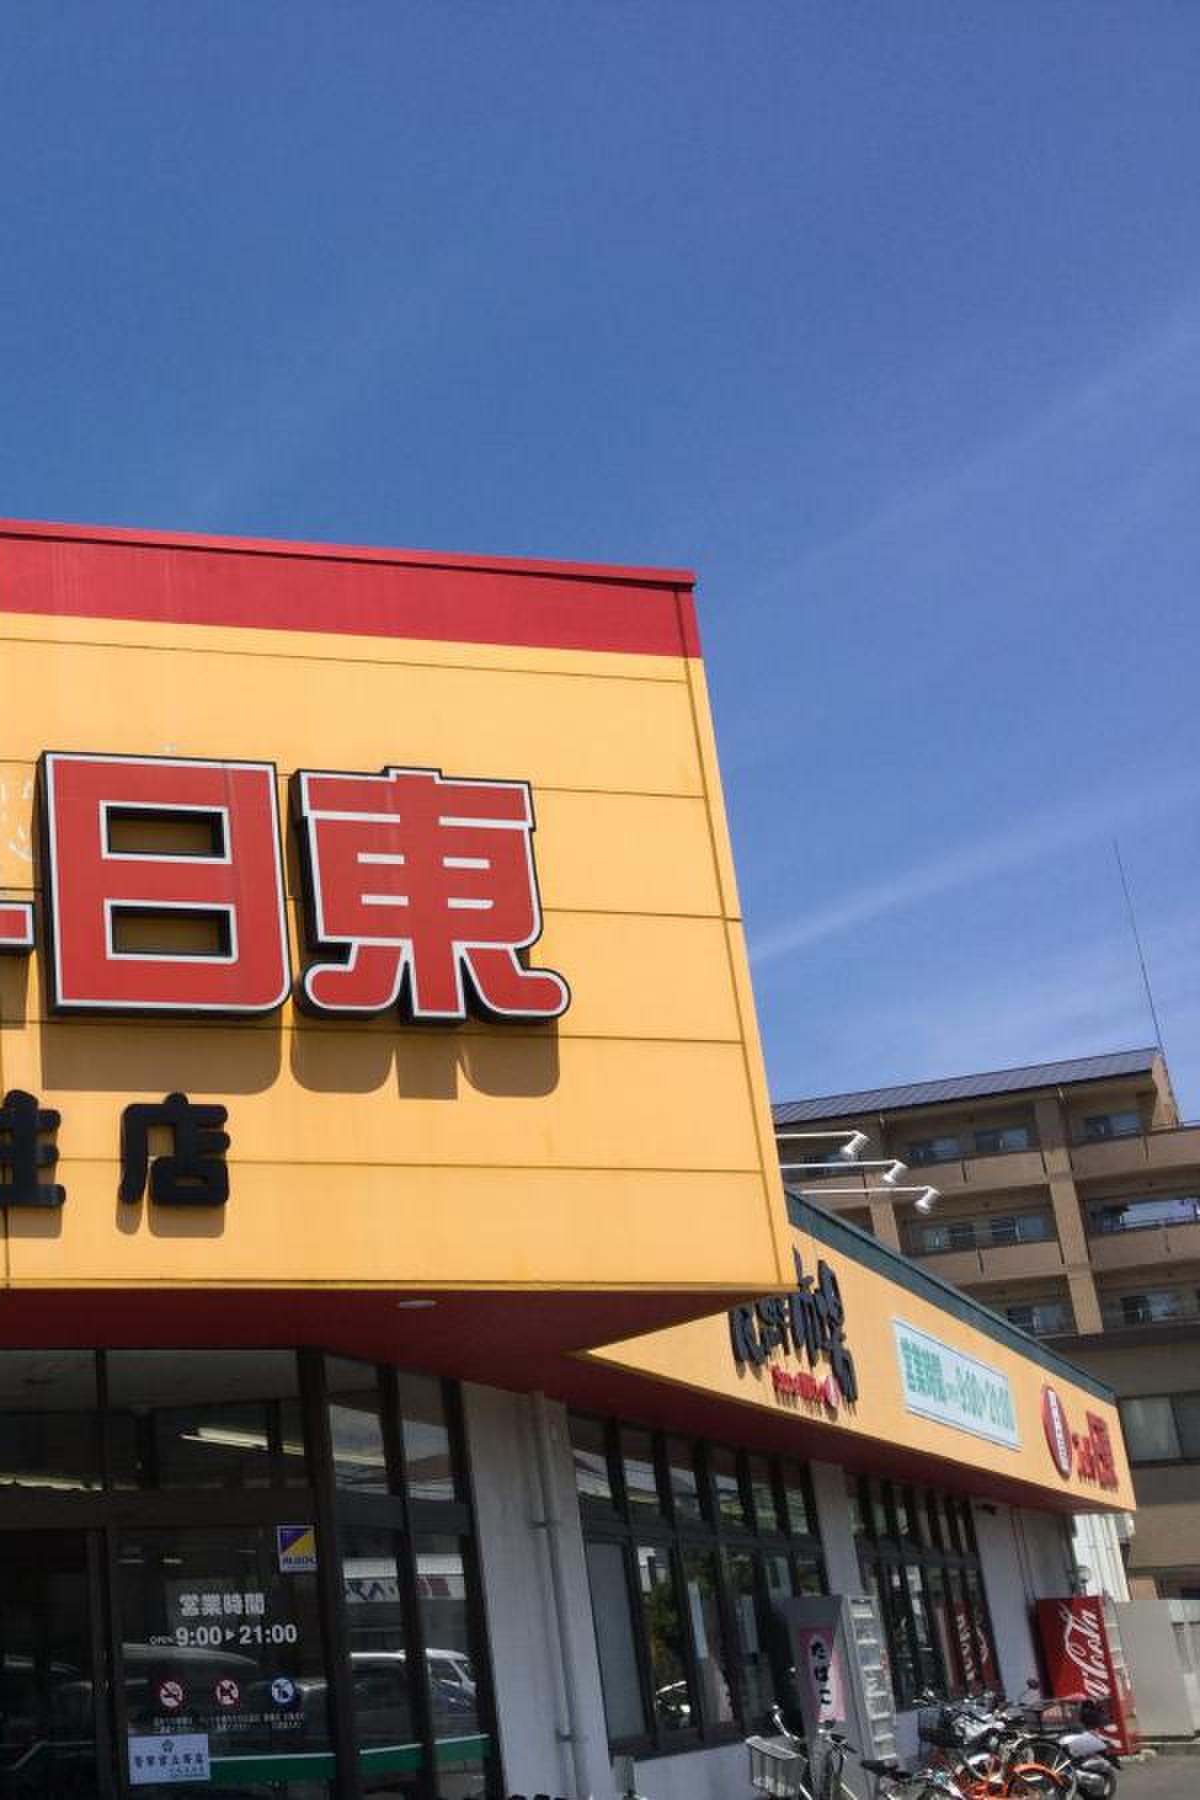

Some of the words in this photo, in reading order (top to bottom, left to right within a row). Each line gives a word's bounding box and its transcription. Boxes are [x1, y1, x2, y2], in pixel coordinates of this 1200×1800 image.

[179, 1592, 265, 1616] 営業時間
[176, 1625, 222, 1647] 9:00
[239, 1624, 298, 1645] 21:00
